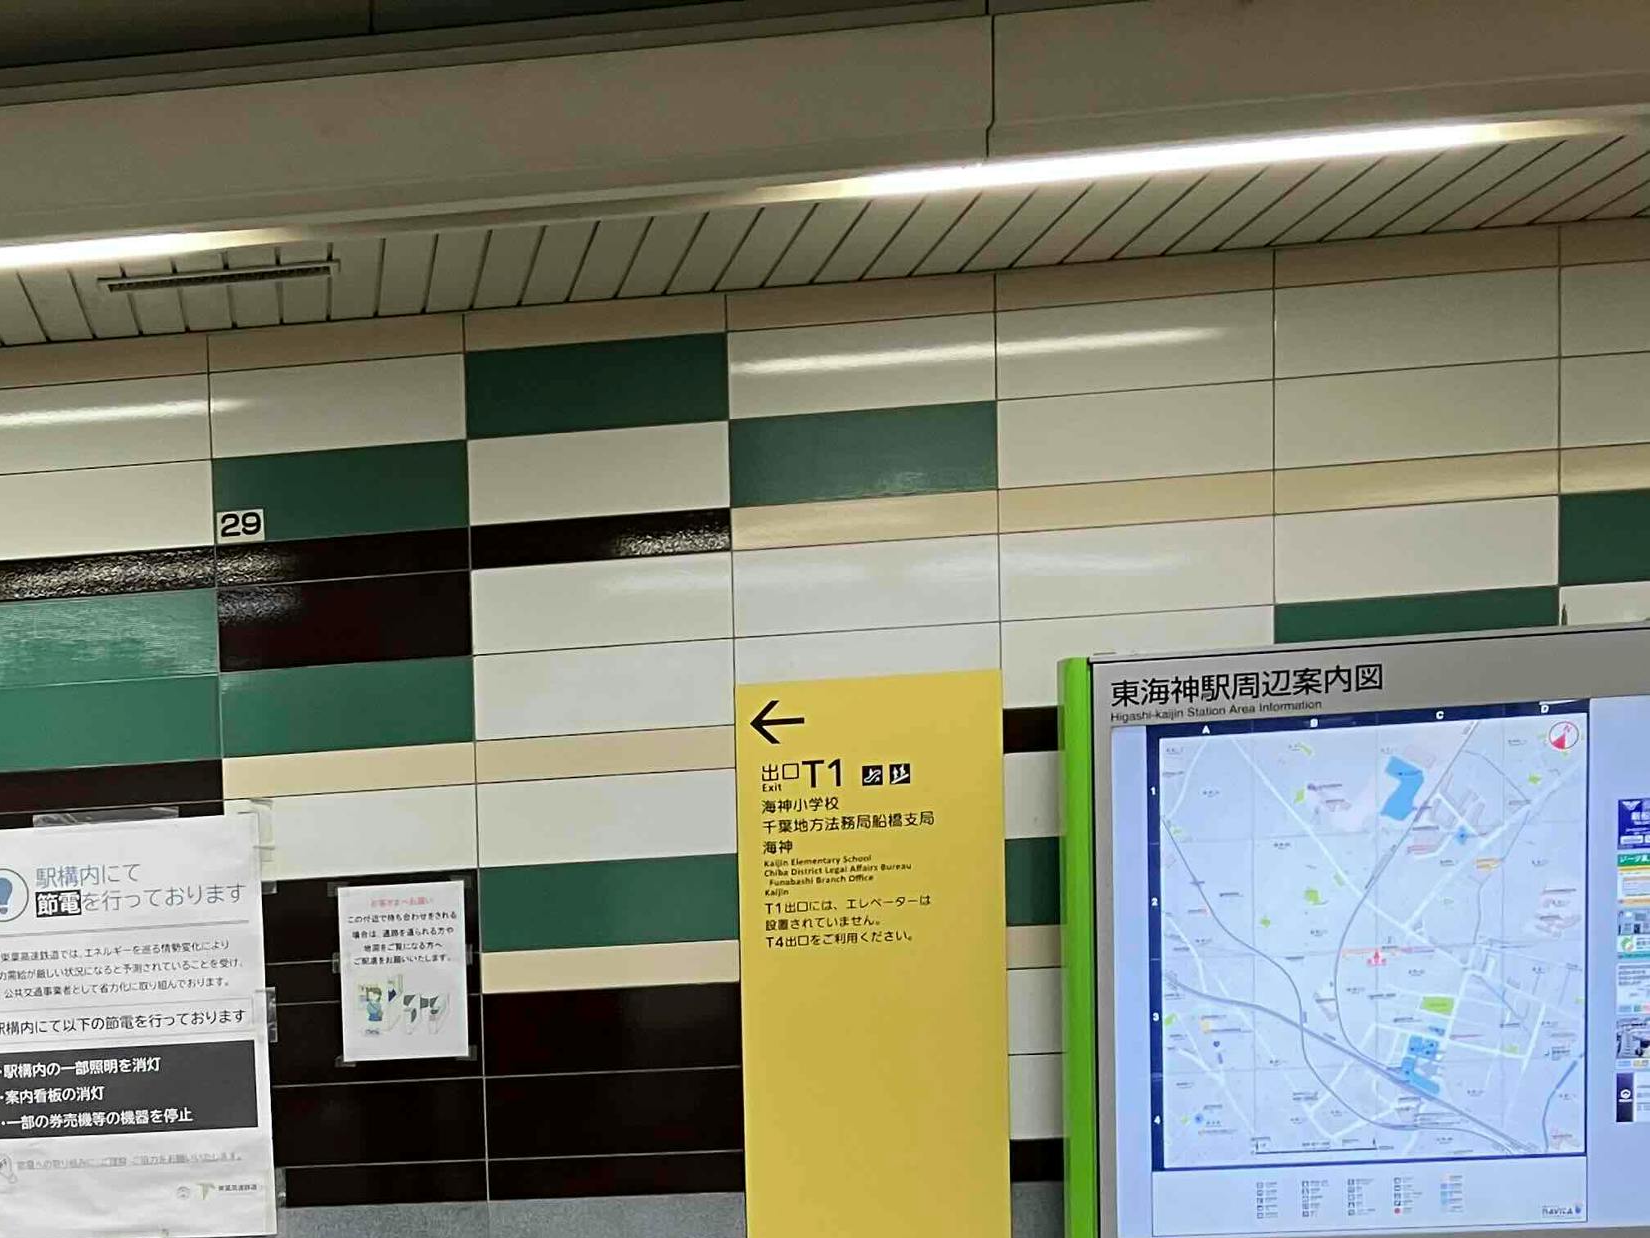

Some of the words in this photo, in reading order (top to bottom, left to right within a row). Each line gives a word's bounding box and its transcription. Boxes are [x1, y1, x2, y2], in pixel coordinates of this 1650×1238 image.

[220, 512, 262, 539] 29
[1111, 663, 1383, 707] 東海神駅周辺案内図
[1111, 707, 1184, 724] Higashi-kaijin
[1187, 703, 1226, 717] Station
[1229, 703, 1257, 714] Area
[1259, 699, 1323, 713] Information
[1435, 710, 1445, 720] C
[1540, 704, 1550, 714] D
[1201, 725, 1211, 734] A
[761, 783, 783, 793] Exit
[761, 796, 840, 814] 海神小学校
[762, 811, 935, 834] 千葉地方法務局船橋支局
[762, 839, 793, 855] 海神
[764, 859, 789, 868] Kaijin
[790, 856, 841, 867] Elementary
[842, 854, 872, 864] School
[36, 862, 141, 887] 駅構内にて
[763, 868, 789, 878] Chiba
[790, 866, 823, 877] District
[824, 865, 848, 875] Legal
[849, 863, 879, 873] Affairs
[880, 862, 912, 871] Bureau
[816, 875, 846, 885] Branch
[848, 873, 875, 883] Office
[35, 883, 246, 917] 節電を行っております
[764, 888, 789, 898] Kaijin
[1151, 897, 1158, 906] 2
[765, 915, 881, 932] 設置されていません。
[766, 930, 913, 949] T4出口をご利用ください。
[1152, 1012, 1160, 1021] 3
[1154, 1116, 1161, 1125] 4
